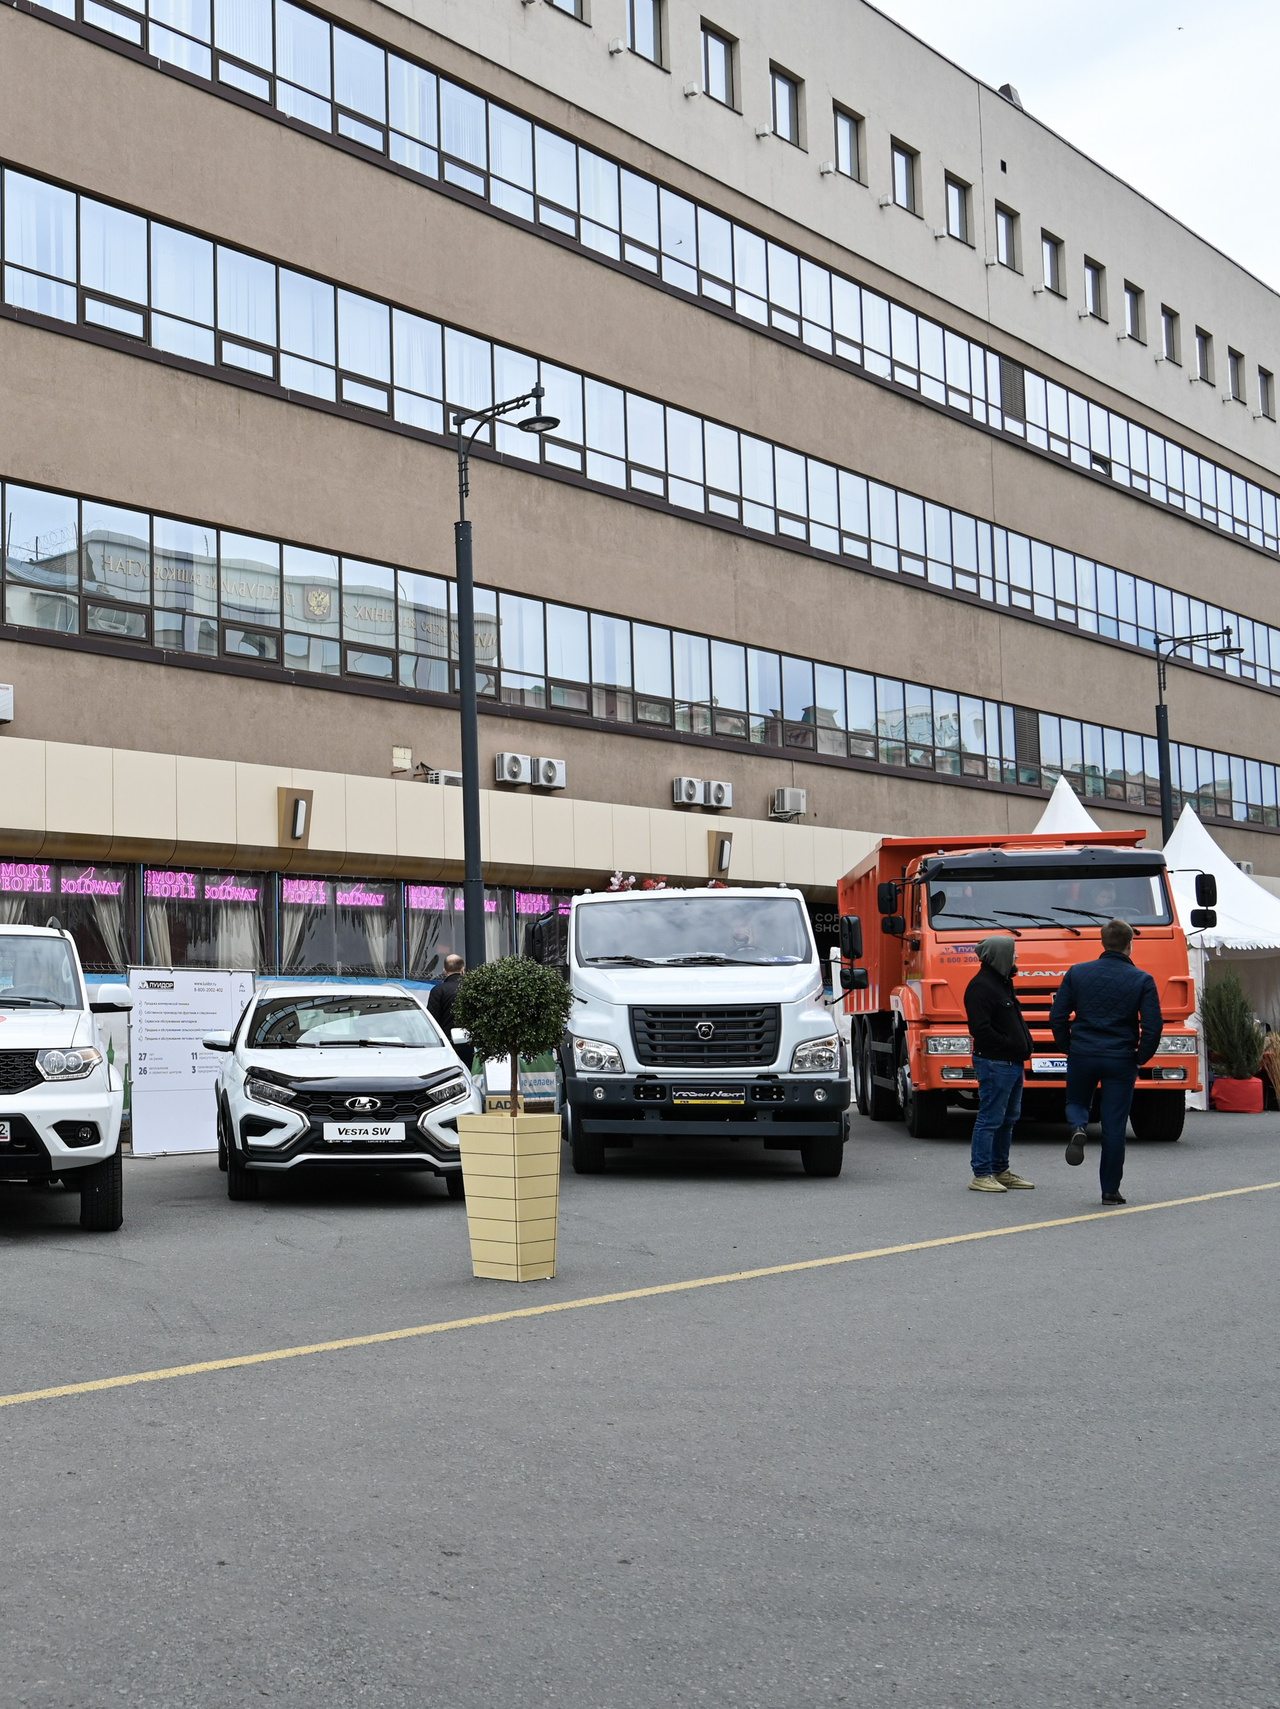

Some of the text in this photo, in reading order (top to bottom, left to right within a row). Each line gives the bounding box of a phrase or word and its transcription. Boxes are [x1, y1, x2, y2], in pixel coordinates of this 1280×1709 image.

[144, 870, 195, 885] SMOKY
[61, 878, 121, 895] SOLOWAY
[144, 883, 196, 898] PEOPLE
[282, 878, 326, 892] SMOKY
[205, 885, 258, 901] SOLOWAY
[282, 890, 326, 904] PEOPLE
[336, 891, 384, 906] SOLOWAY
[815, 923, 840, 933] SHO
[138, 1053, 147, 1061] 27
[191, 1052, 198, 1060] 11
[138, 1067, 147, 1075] 26
[191, 1066, 196, 1074] 3
[337, 1127, 391, 1136] VESTA SW
